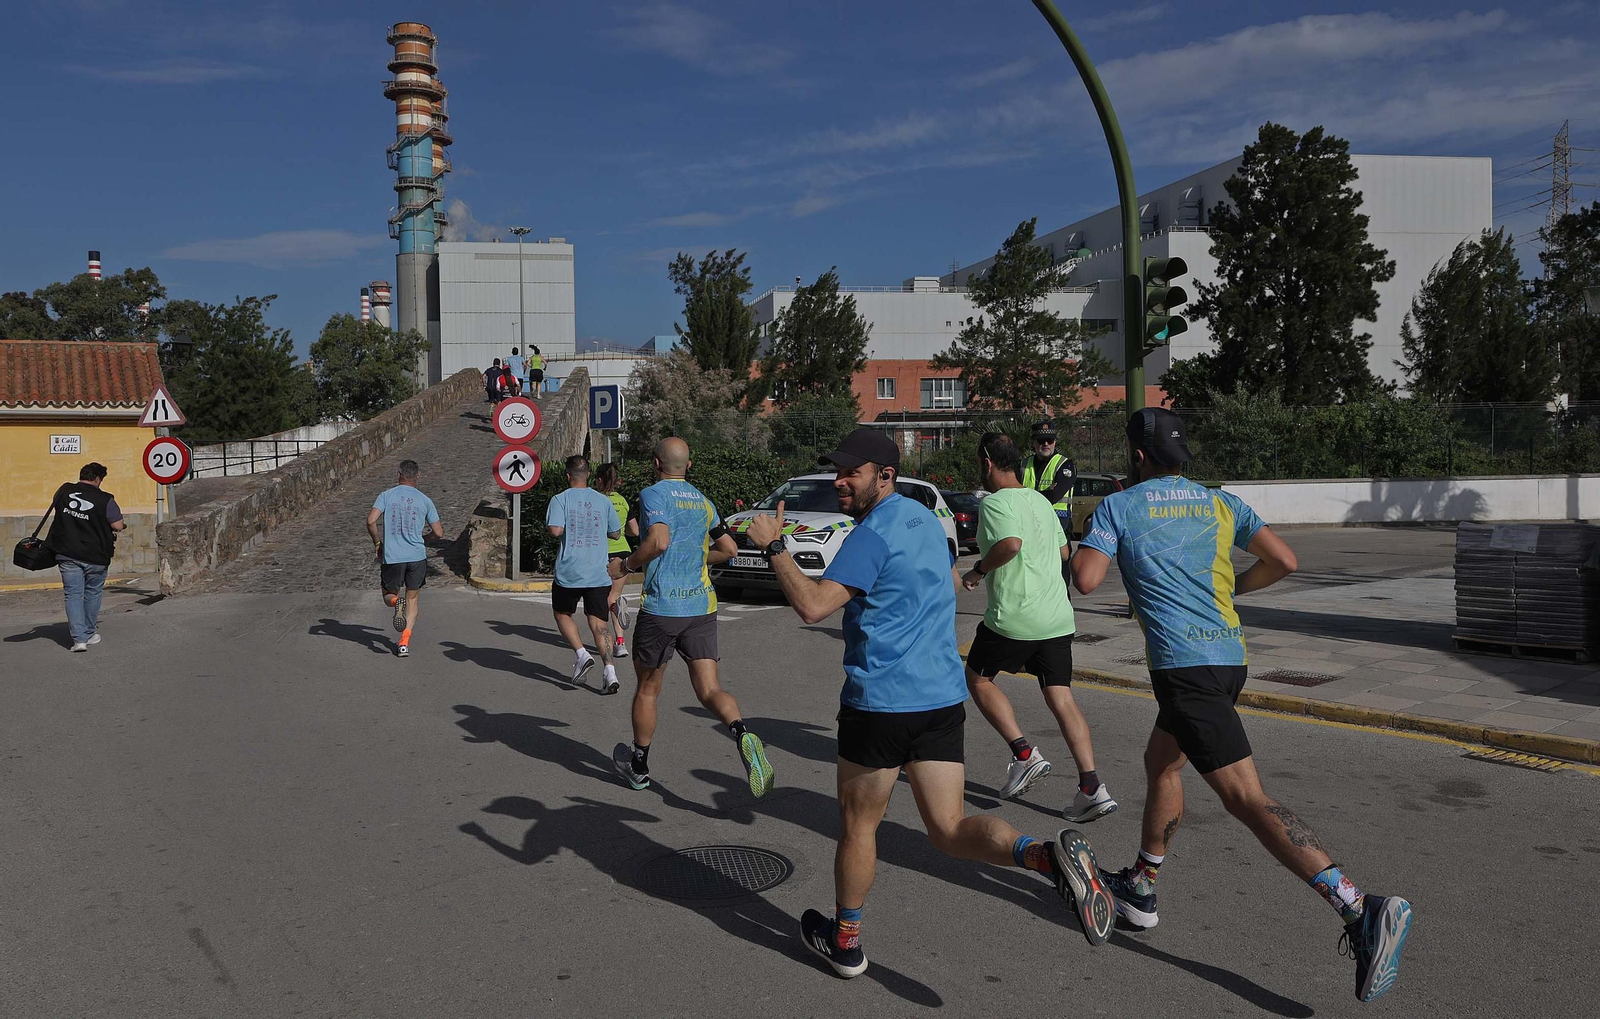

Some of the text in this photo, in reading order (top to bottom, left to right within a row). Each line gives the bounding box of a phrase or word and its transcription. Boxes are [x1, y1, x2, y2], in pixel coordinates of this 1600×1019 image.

[594, 390, 613, 425] P
[53, 444, 78, 452] Cádiz
[153, 452, 177, 468] 20
[1145, 489, 1208, 502] BAJADILLA
[63, 507, 90, 520] PRENSA
[1149, 504, 1212, 519] RUNNING
[733, 557, 751, 566] 8980
